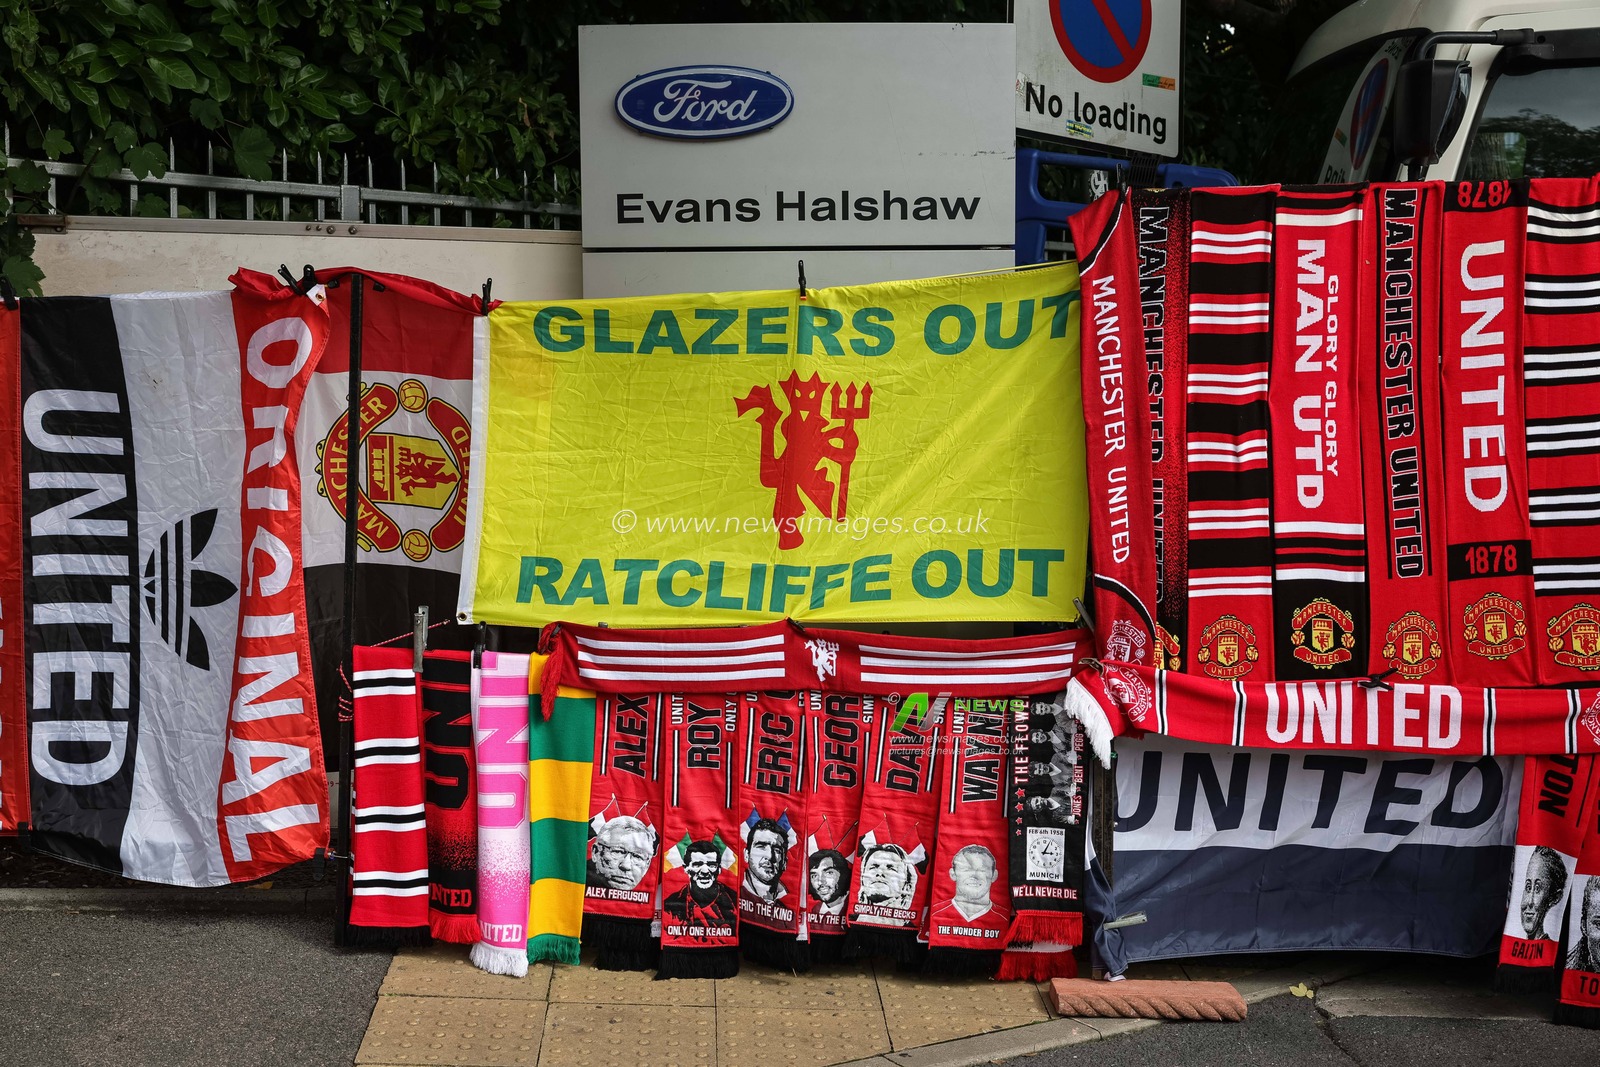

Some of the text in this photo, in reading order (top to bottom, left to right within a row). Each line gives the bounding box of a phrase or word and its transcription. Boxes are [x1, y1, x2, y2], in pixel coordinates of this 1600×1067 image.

[652, 79, 757, 123] Ford
[1025, 81, 1063, 118] No
[1074, 91, 1167, 145] loading
[616, 190, 981, 224] Evans Halshaw
[1457, 180, 1511, 208] 1878
[533, 290, 1081, 357] GLAZERS OUT
[1293, 239, 1326, 509] MAN UTD
[1324, 275, 1340, 476] GLORY GLORY
[1384, 188, 1425, 579] MANCHESTER UNITED
[1460, 240, 1508, 512] UNITED
[1092, 275, 1130, 564] MANCHESTER UNITED
[329, 396, 389, 540] MACHESER
[1465, 544, 1518, 575] 1878
[22, 388, 131, 787] UNITED
[222, 316, 321, 863] ORIGINAL
[516, 548, 1065, 612] RATCLIFFE OUT
[1296, 603, 1347, 626] MANCHESTER
[1468, 598, 1518, 621] MANCHESTER
[1206, 619, 1250, 640] MANCHESTER
[1391, 617, 1433, 637] MANCHESTER
[1305, 653, 1340, 663] UNITED
[1479, 644, 1514, 654] UNITED
[1211, 665, 1245, 676] UNITED
[1396, 663, 1430, 674] UNITED
[725, 699, 737, 732] ONLY
[1265, 681, 1462, 749] UNITED
[477, 652, 530, 829] UNI
[612, 693, 650, 778] ALEX
[687, 701, 722, 770] ROY
[1015, 696, 1029, 785] THE FLOWE
[756, 712, 795, 795] ERIC
[1073, 765, 1084, 783] BENT
[1071, 795, 1083, 817] JONES
[1114, 750, 1503, 836] UNITED
[1012, 884, 1078, 900] WE'LL NEVER DIE
[1029, 871, 1060, 880] MUNICH
[585, 886, 649, 903] ALEX FERGUSON
[756, 903, 772, 916] THE
[773, 906, 793, 922] KING
[826, 914, 841, 926] THE
[854, 903, 917, 920] SIMPLY THE BECKS
[667, 925, 733, 938] ONLY ONE KEANO
[938, 925, 1000, 939] THE WONDER BOY
